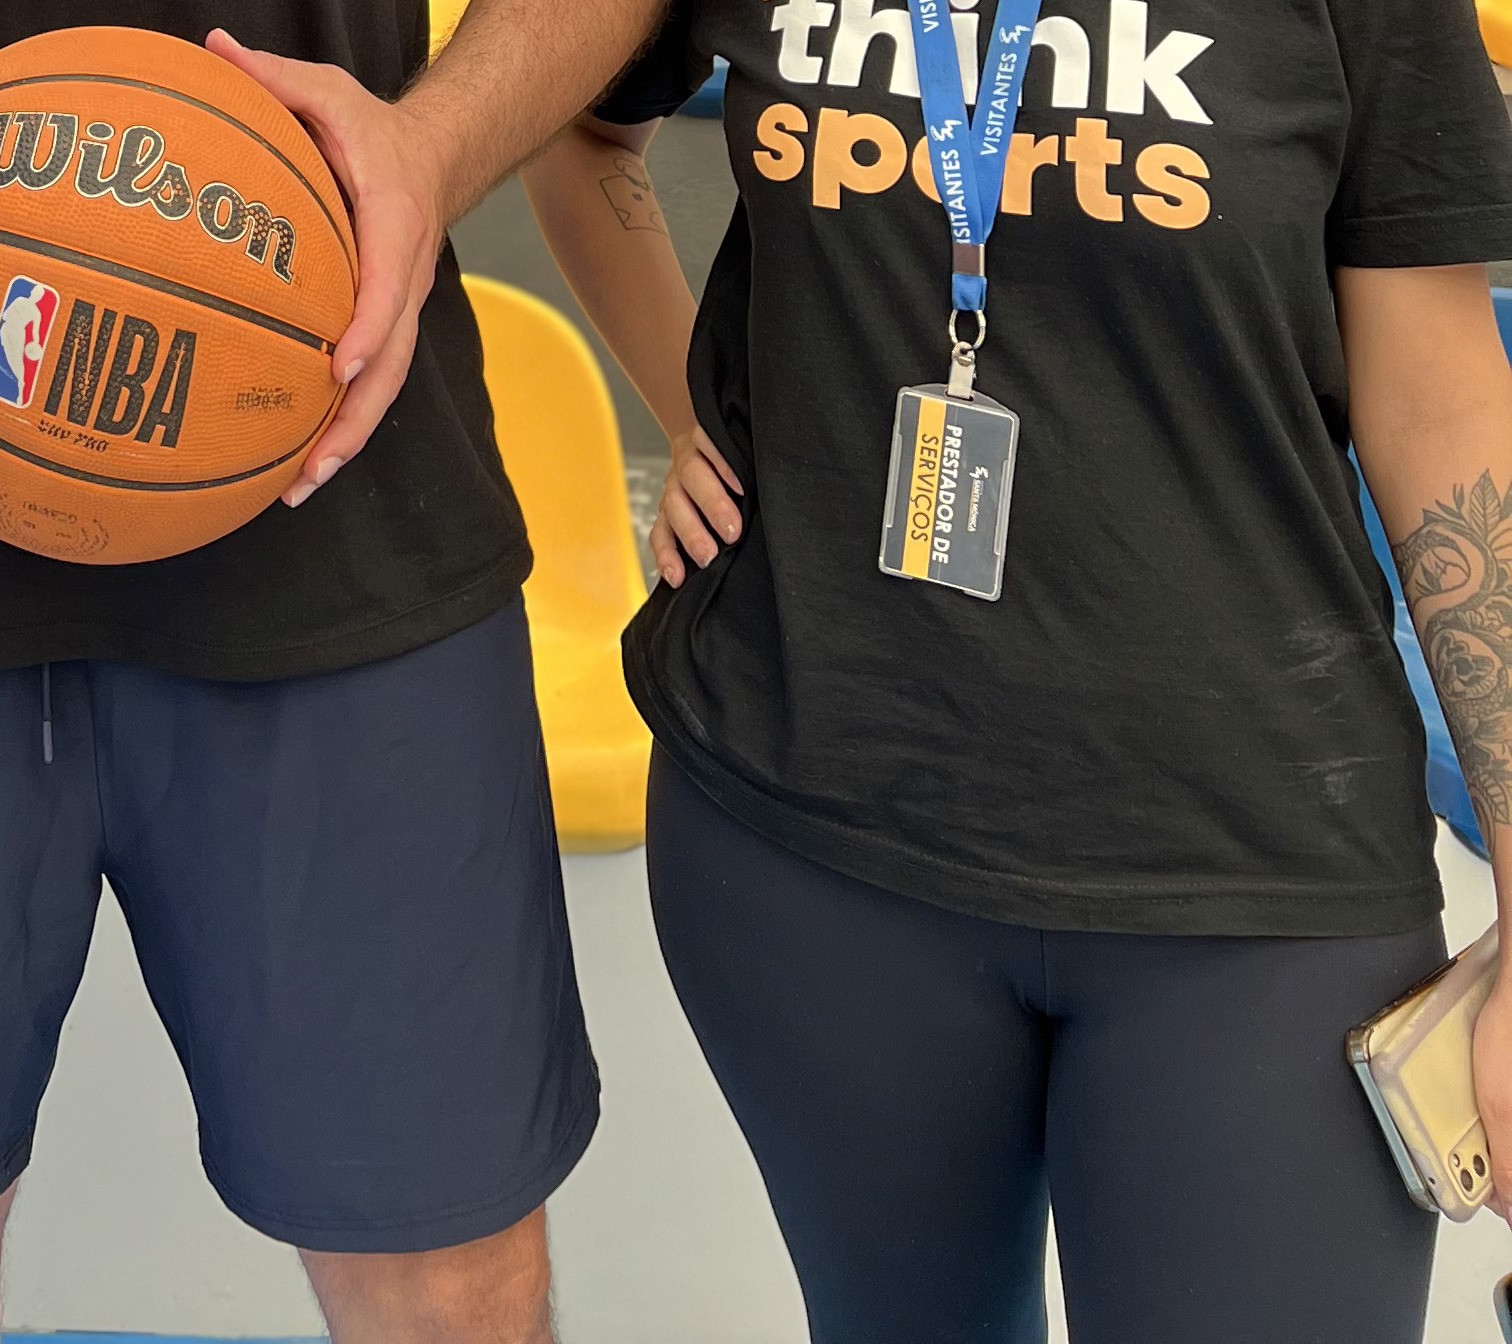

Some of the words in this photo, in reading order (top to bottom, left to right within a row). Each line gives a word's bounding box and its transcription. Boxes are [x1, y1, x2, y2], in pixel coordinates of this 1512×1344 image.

[980, 52, 1018, 156] VISITANTES
[753, 101, 1212, 230] sprts
[941, 148, 971, 245] ISITANTES
[43, 297, 198, 450] NBA
[910, 433, 939, 543] SERVIÇOS
[934, 424, 963, 535] PRESTADOR
[932, 538, 949, 564] DE
